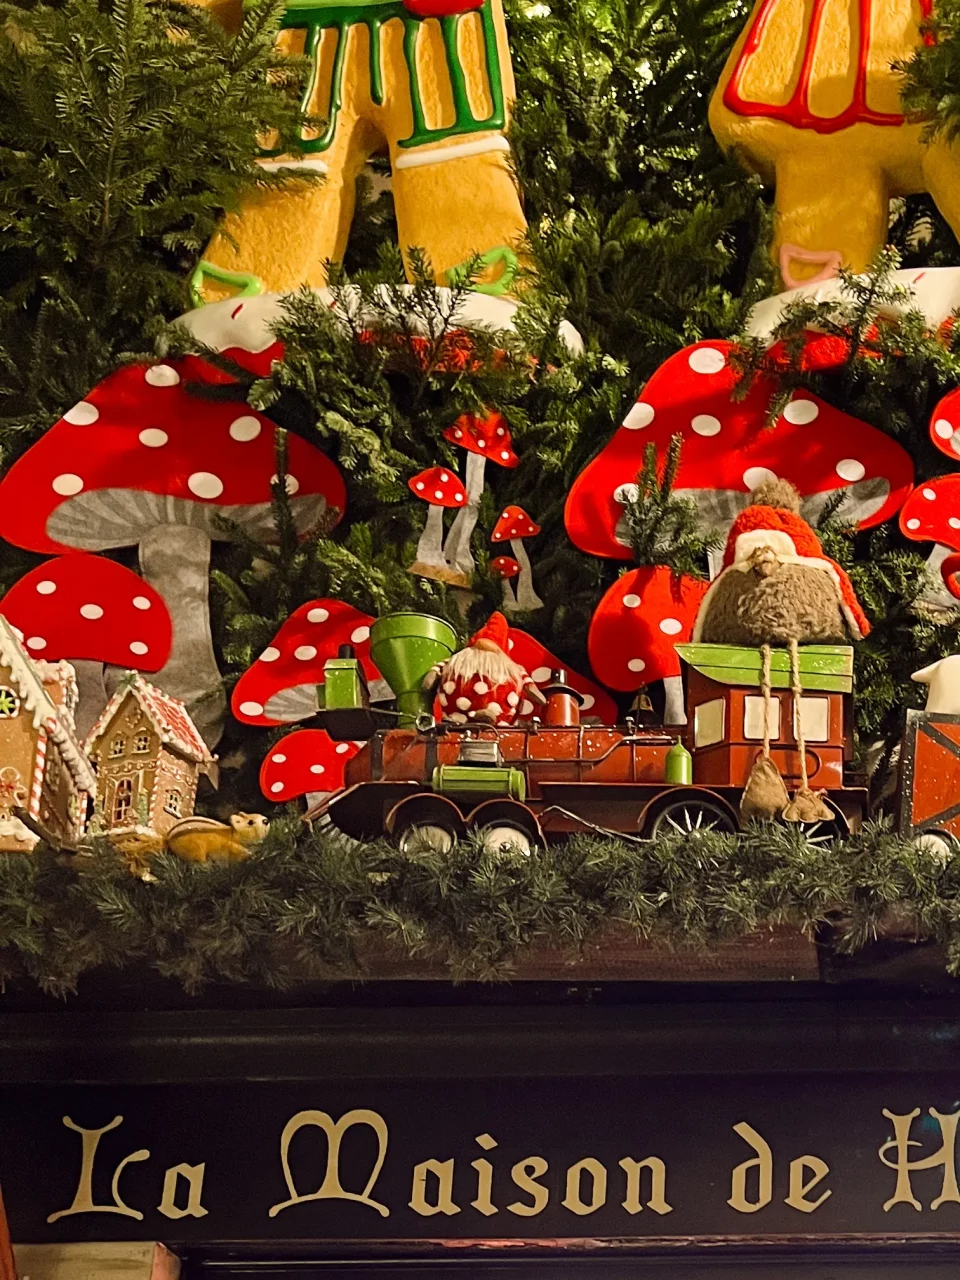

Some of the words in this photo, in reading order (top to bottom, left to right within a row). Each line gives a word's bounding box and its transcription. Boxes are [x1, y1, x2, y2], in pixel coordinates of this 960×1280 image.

[46, 1114, 209, 1224] La
[268, 1108, 673, 1218] Maison
[726, 1121, 832, 1214] de
